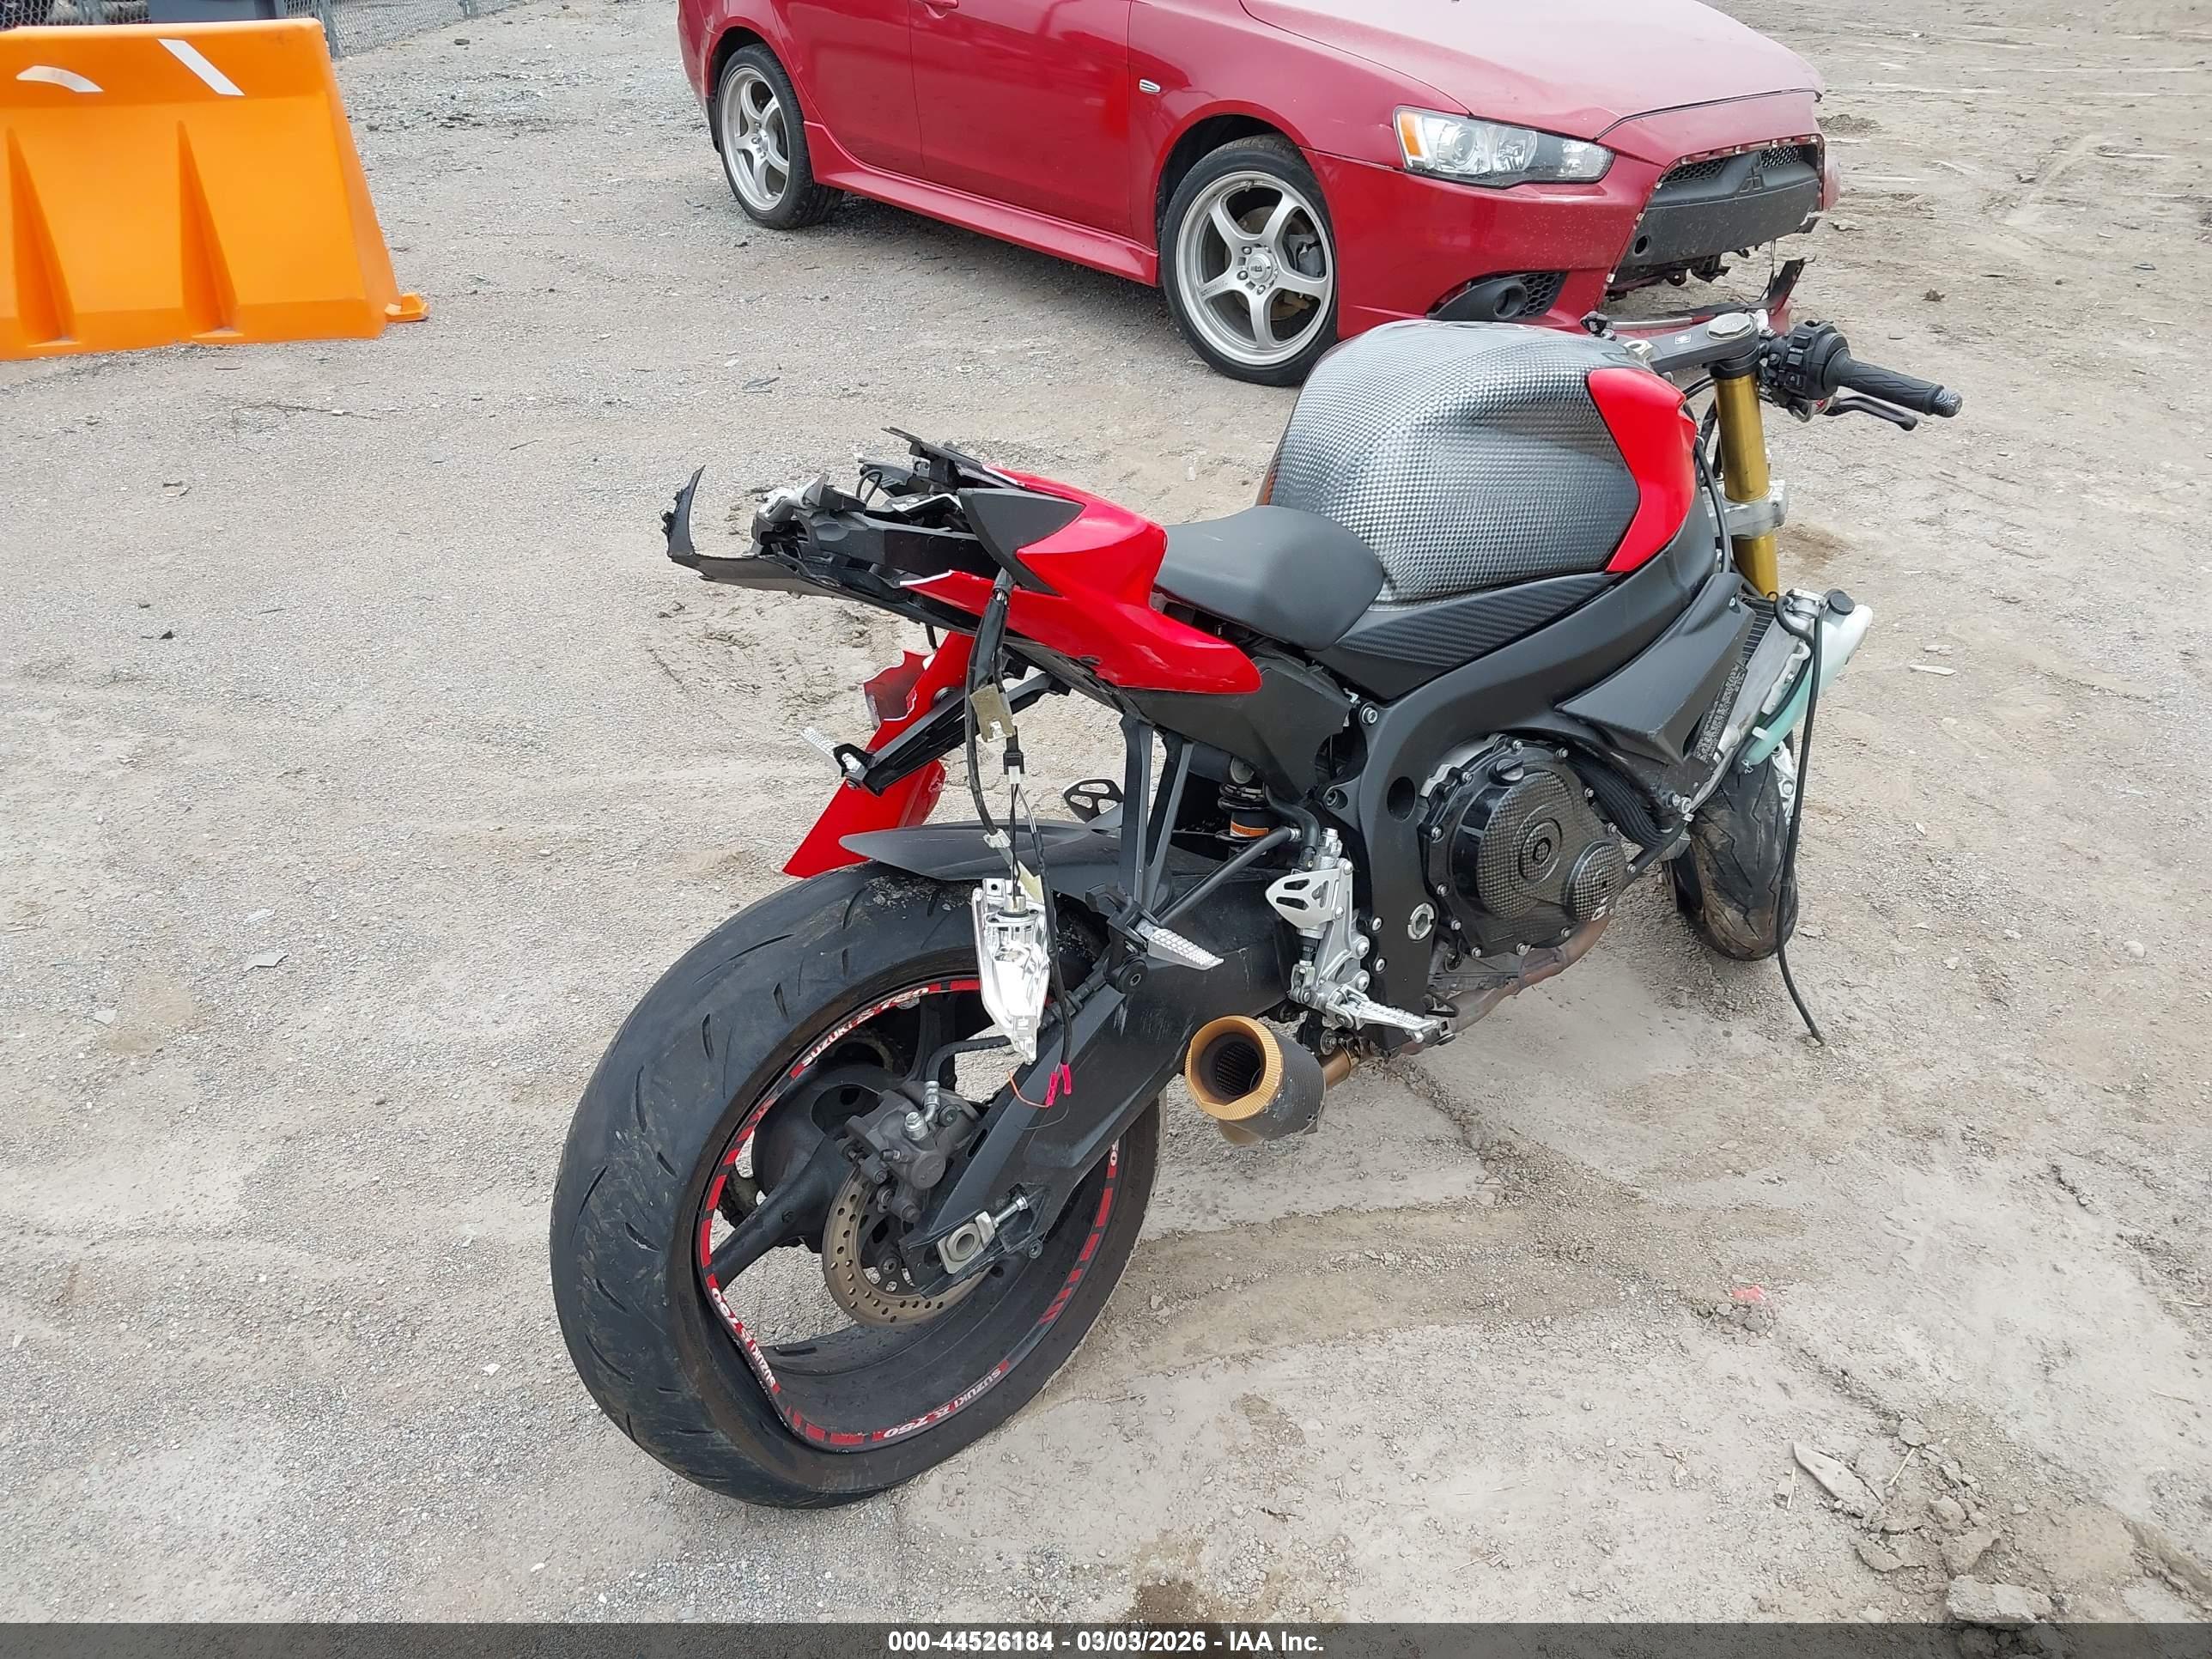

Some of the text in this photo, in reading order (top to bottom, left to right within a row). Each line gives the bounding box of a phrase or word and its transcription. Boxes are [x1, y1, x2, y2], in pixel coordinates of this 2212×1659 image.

[802, 1020, 853, 1067] SUZUKI
[711, 1287, 739, 1329] 750
[750, 1343, 776, 1388] SUZUKI
[954, 1367, 1002, 1409] SUZUKI
[883, 1415, 929, 1438] 750
